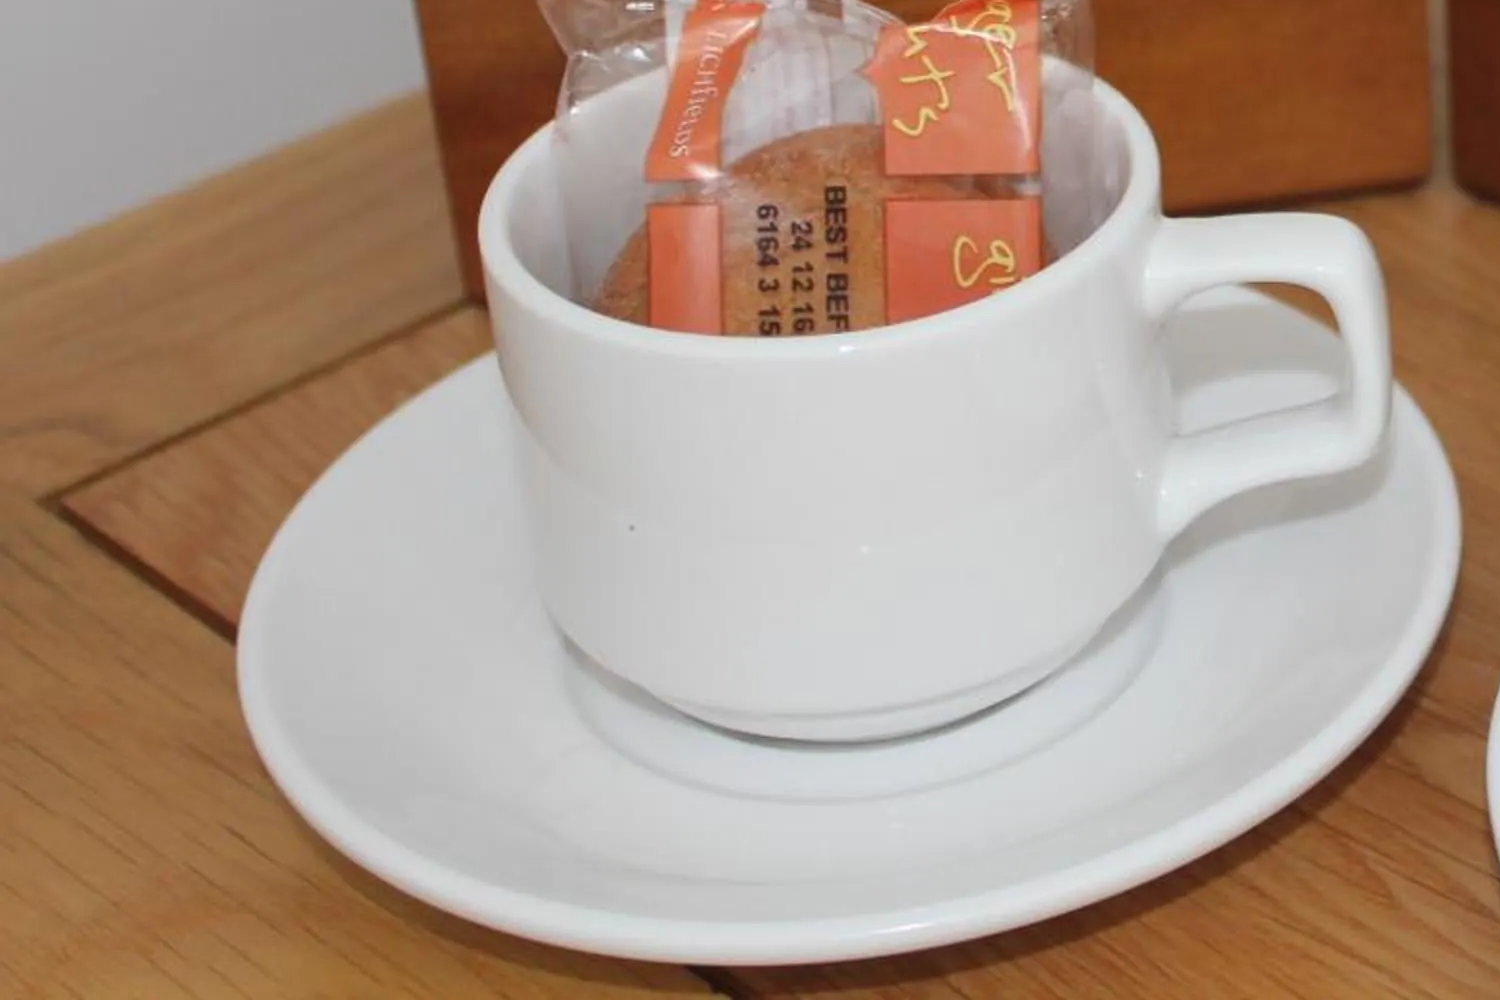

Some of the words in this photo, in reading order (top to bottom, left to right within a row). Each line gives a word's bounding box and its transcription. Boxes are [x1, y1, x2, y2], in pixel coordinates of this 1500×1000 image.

[756, 204, 779, 267] 6164
[791, 220, 814, 251] 24
[825, 185, 849, 264] BEST
[758, 278, 779, 292] 3
[792, 261, 814, 292] 12
[792, 302, 815, 334] 16
